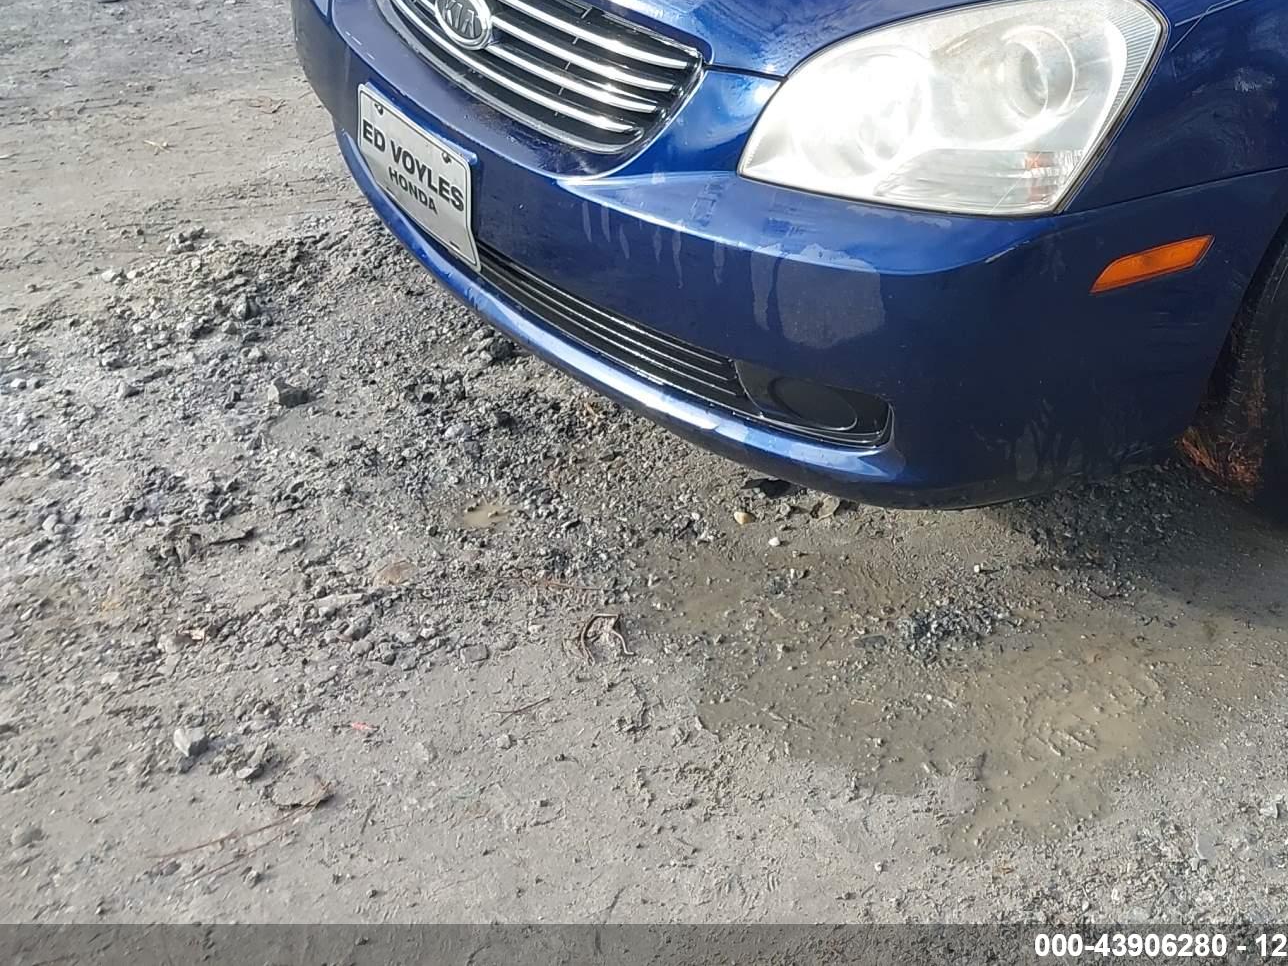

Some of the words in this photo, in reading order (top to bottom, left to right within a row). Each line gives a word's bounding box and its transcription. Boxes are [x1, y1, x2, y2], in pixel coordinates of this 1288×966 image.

[362, 119, 386, 152] ED
[390, 139, 465, 212] VOYLES
[388, 166, 438, 215] HONDA
